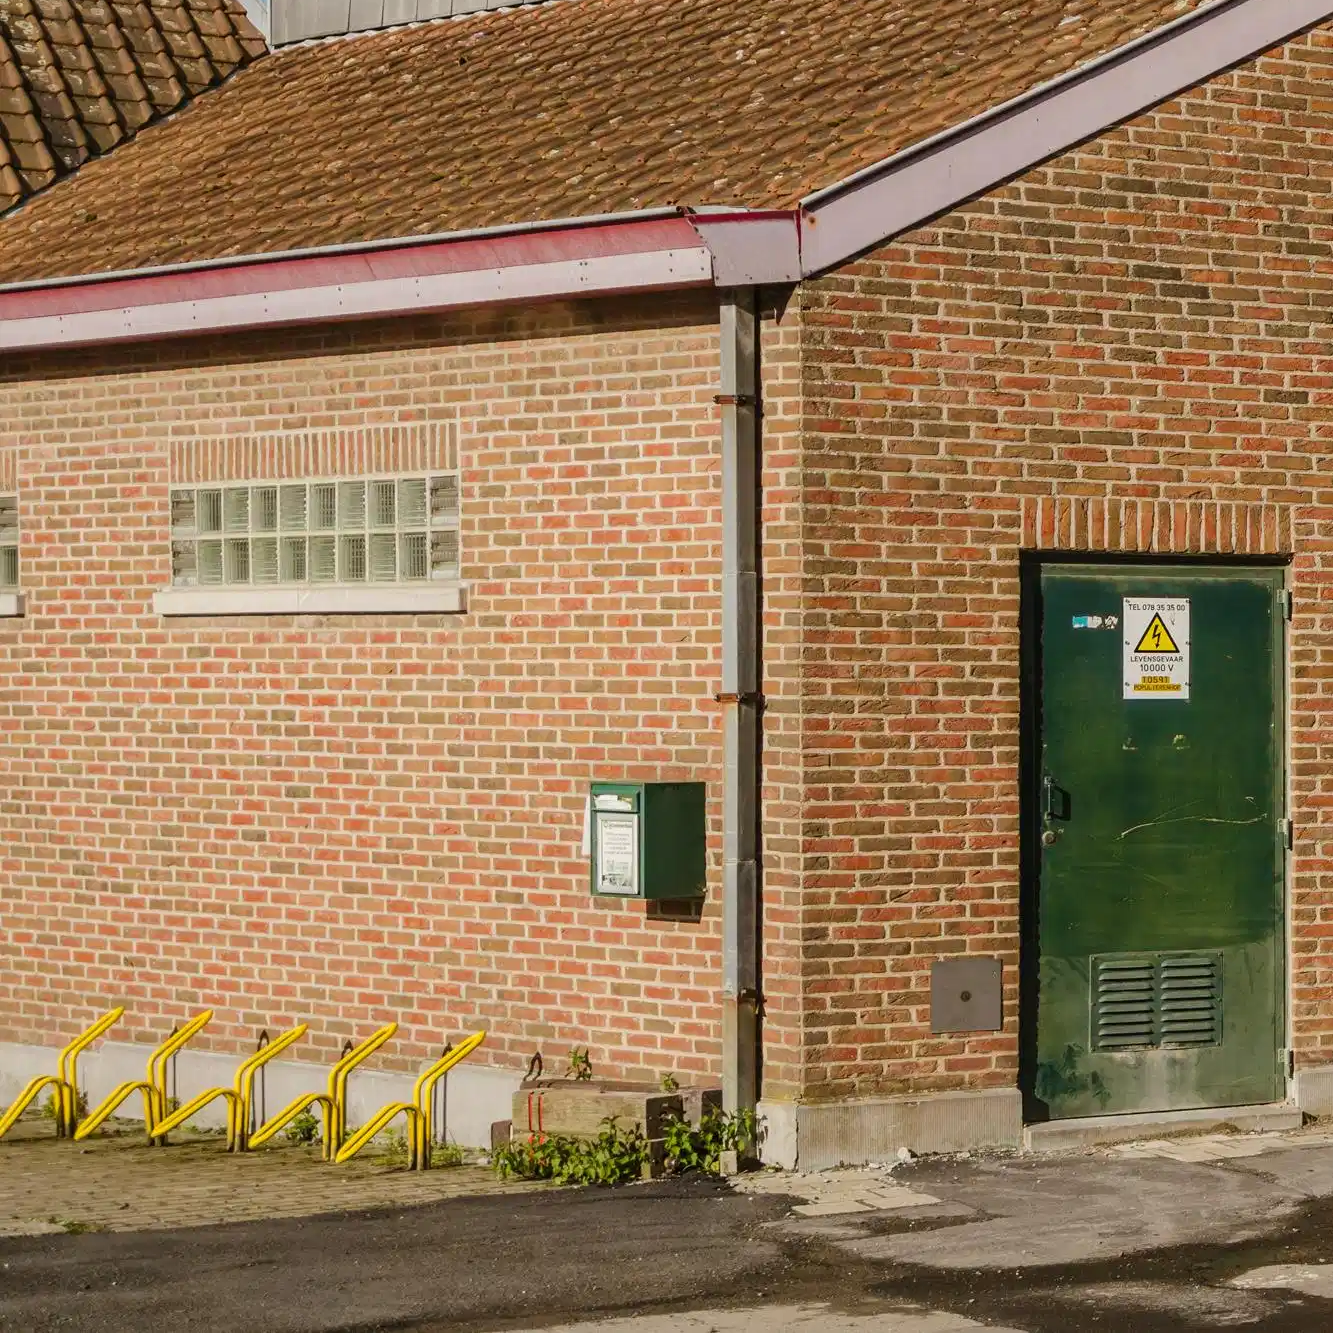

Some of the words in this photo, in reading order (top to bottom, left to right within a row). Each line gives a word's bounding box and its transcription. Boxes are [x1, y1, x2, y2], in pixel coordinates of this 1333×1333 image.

[1129, 603, 1141, 611] TEL
[1142, 603, 1155, 611] 078
[1156, 603, 1165, 611] 35
[1166, 603, 1175, 611] 35
[1167, 664, 1174, 672] V
